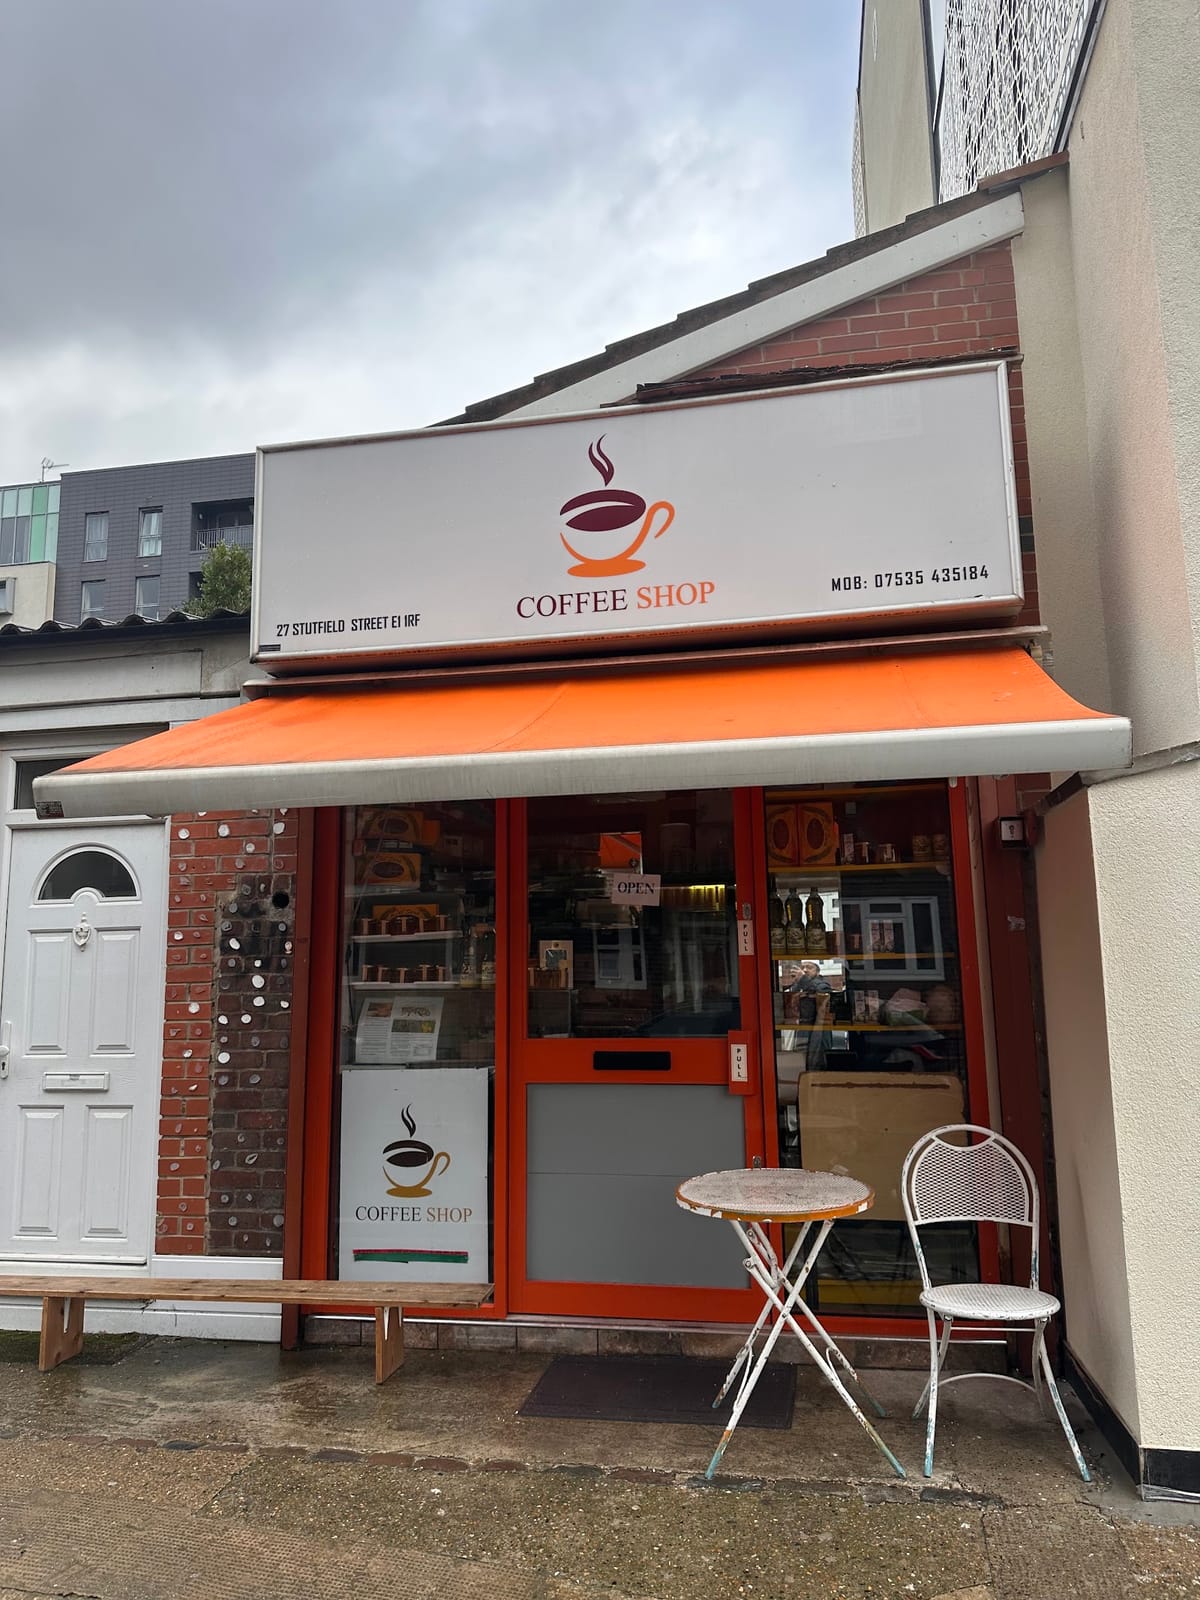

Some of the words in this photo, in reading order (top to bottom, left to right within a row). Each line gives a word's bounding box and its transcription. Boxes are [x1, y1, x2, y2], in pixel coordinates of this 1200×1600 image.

[831, 576, 867, 591] MOB:
[875, 570, 924, 588] 07535
[931, 565, 989, 583] 435184
[516, 589, 628, 618] COFFEE
[636, 581, 715, 609] SHOP
[276, 623, 290, 637] 27
[292, 619, 345, 636] STUTFIELD
[351, 616, 389, 631] STREET
[617, 880, 656, 895] OPEN
[355, 1205, 422, 1222] COFFEE
[426, 1207, 473, 1223] SHOP
